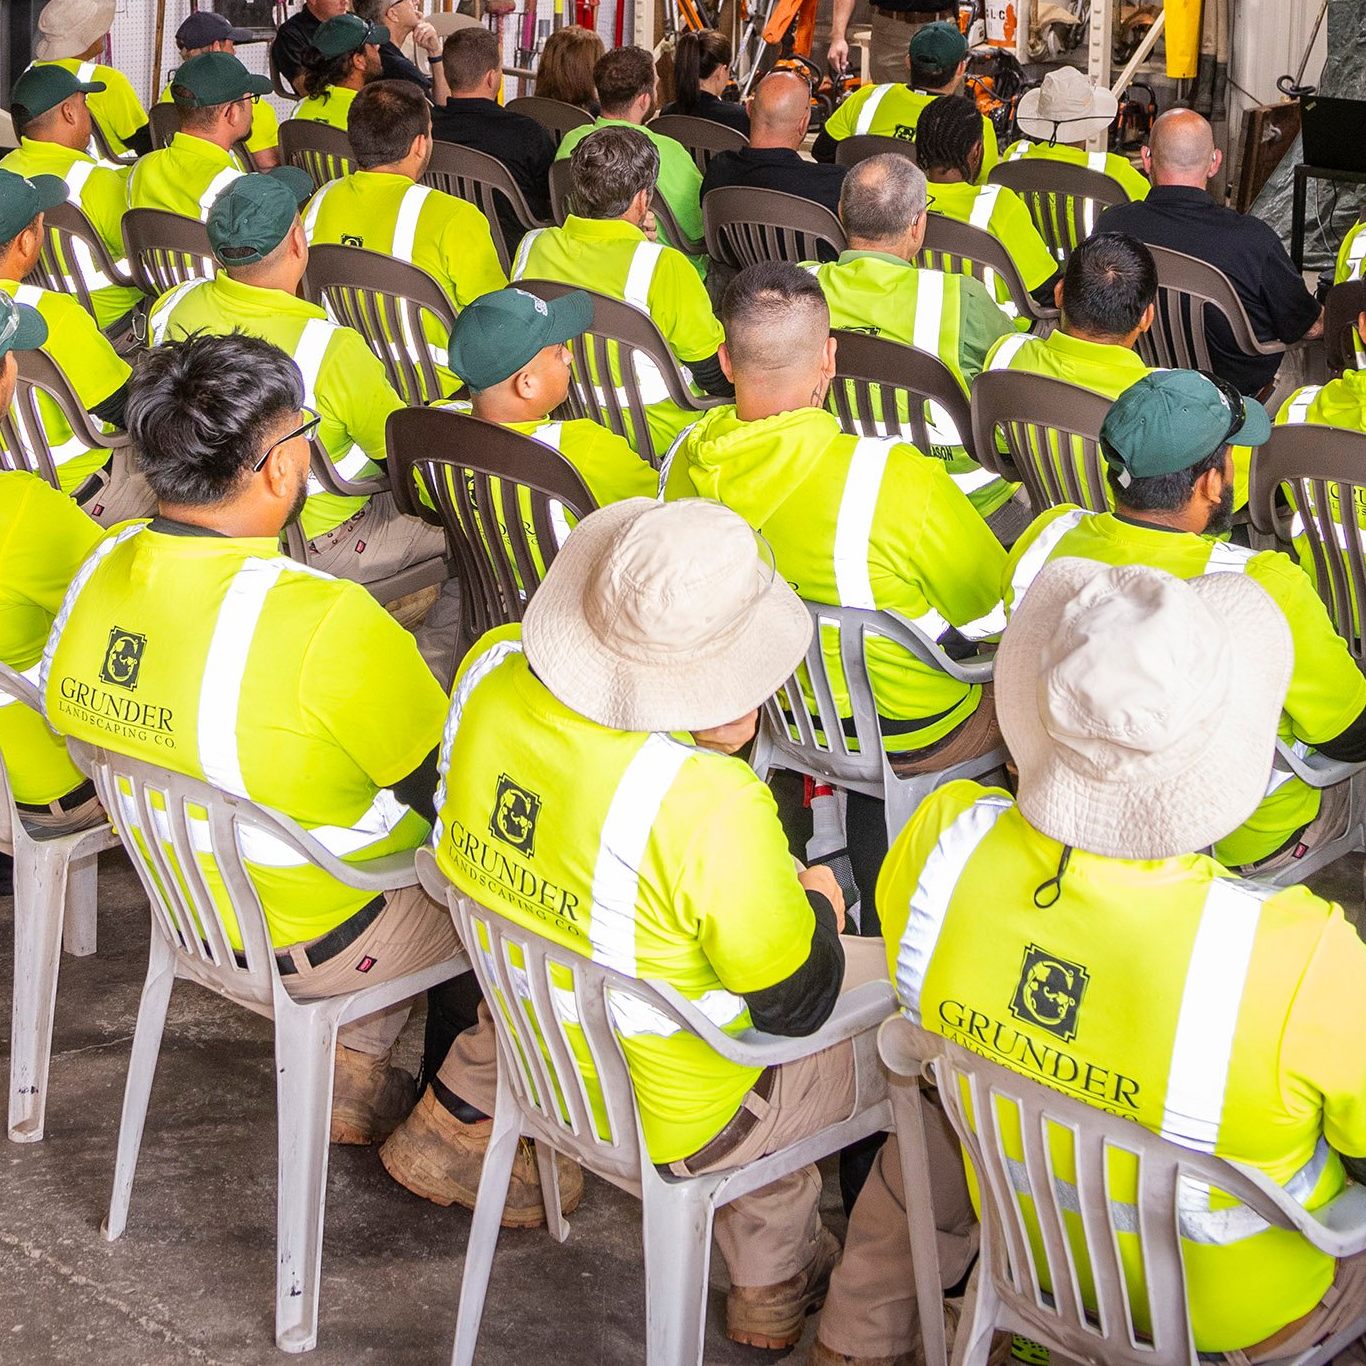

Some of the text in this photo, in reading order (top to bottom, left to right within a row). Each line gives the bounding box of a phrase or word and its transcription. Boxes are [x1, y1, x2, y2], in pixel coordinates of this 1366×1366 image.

[930, 444, 954, 462] ASON
[58, 700, 178, 749] LANDSCAPING CO.
[60, 676, 176, 732] GRUNDER
[449, 845, 548, 921] LANDSCAPING
[451, 820, 581, 922] GRUNDER
[938, 999, 1141, 1110] GRUNDER
